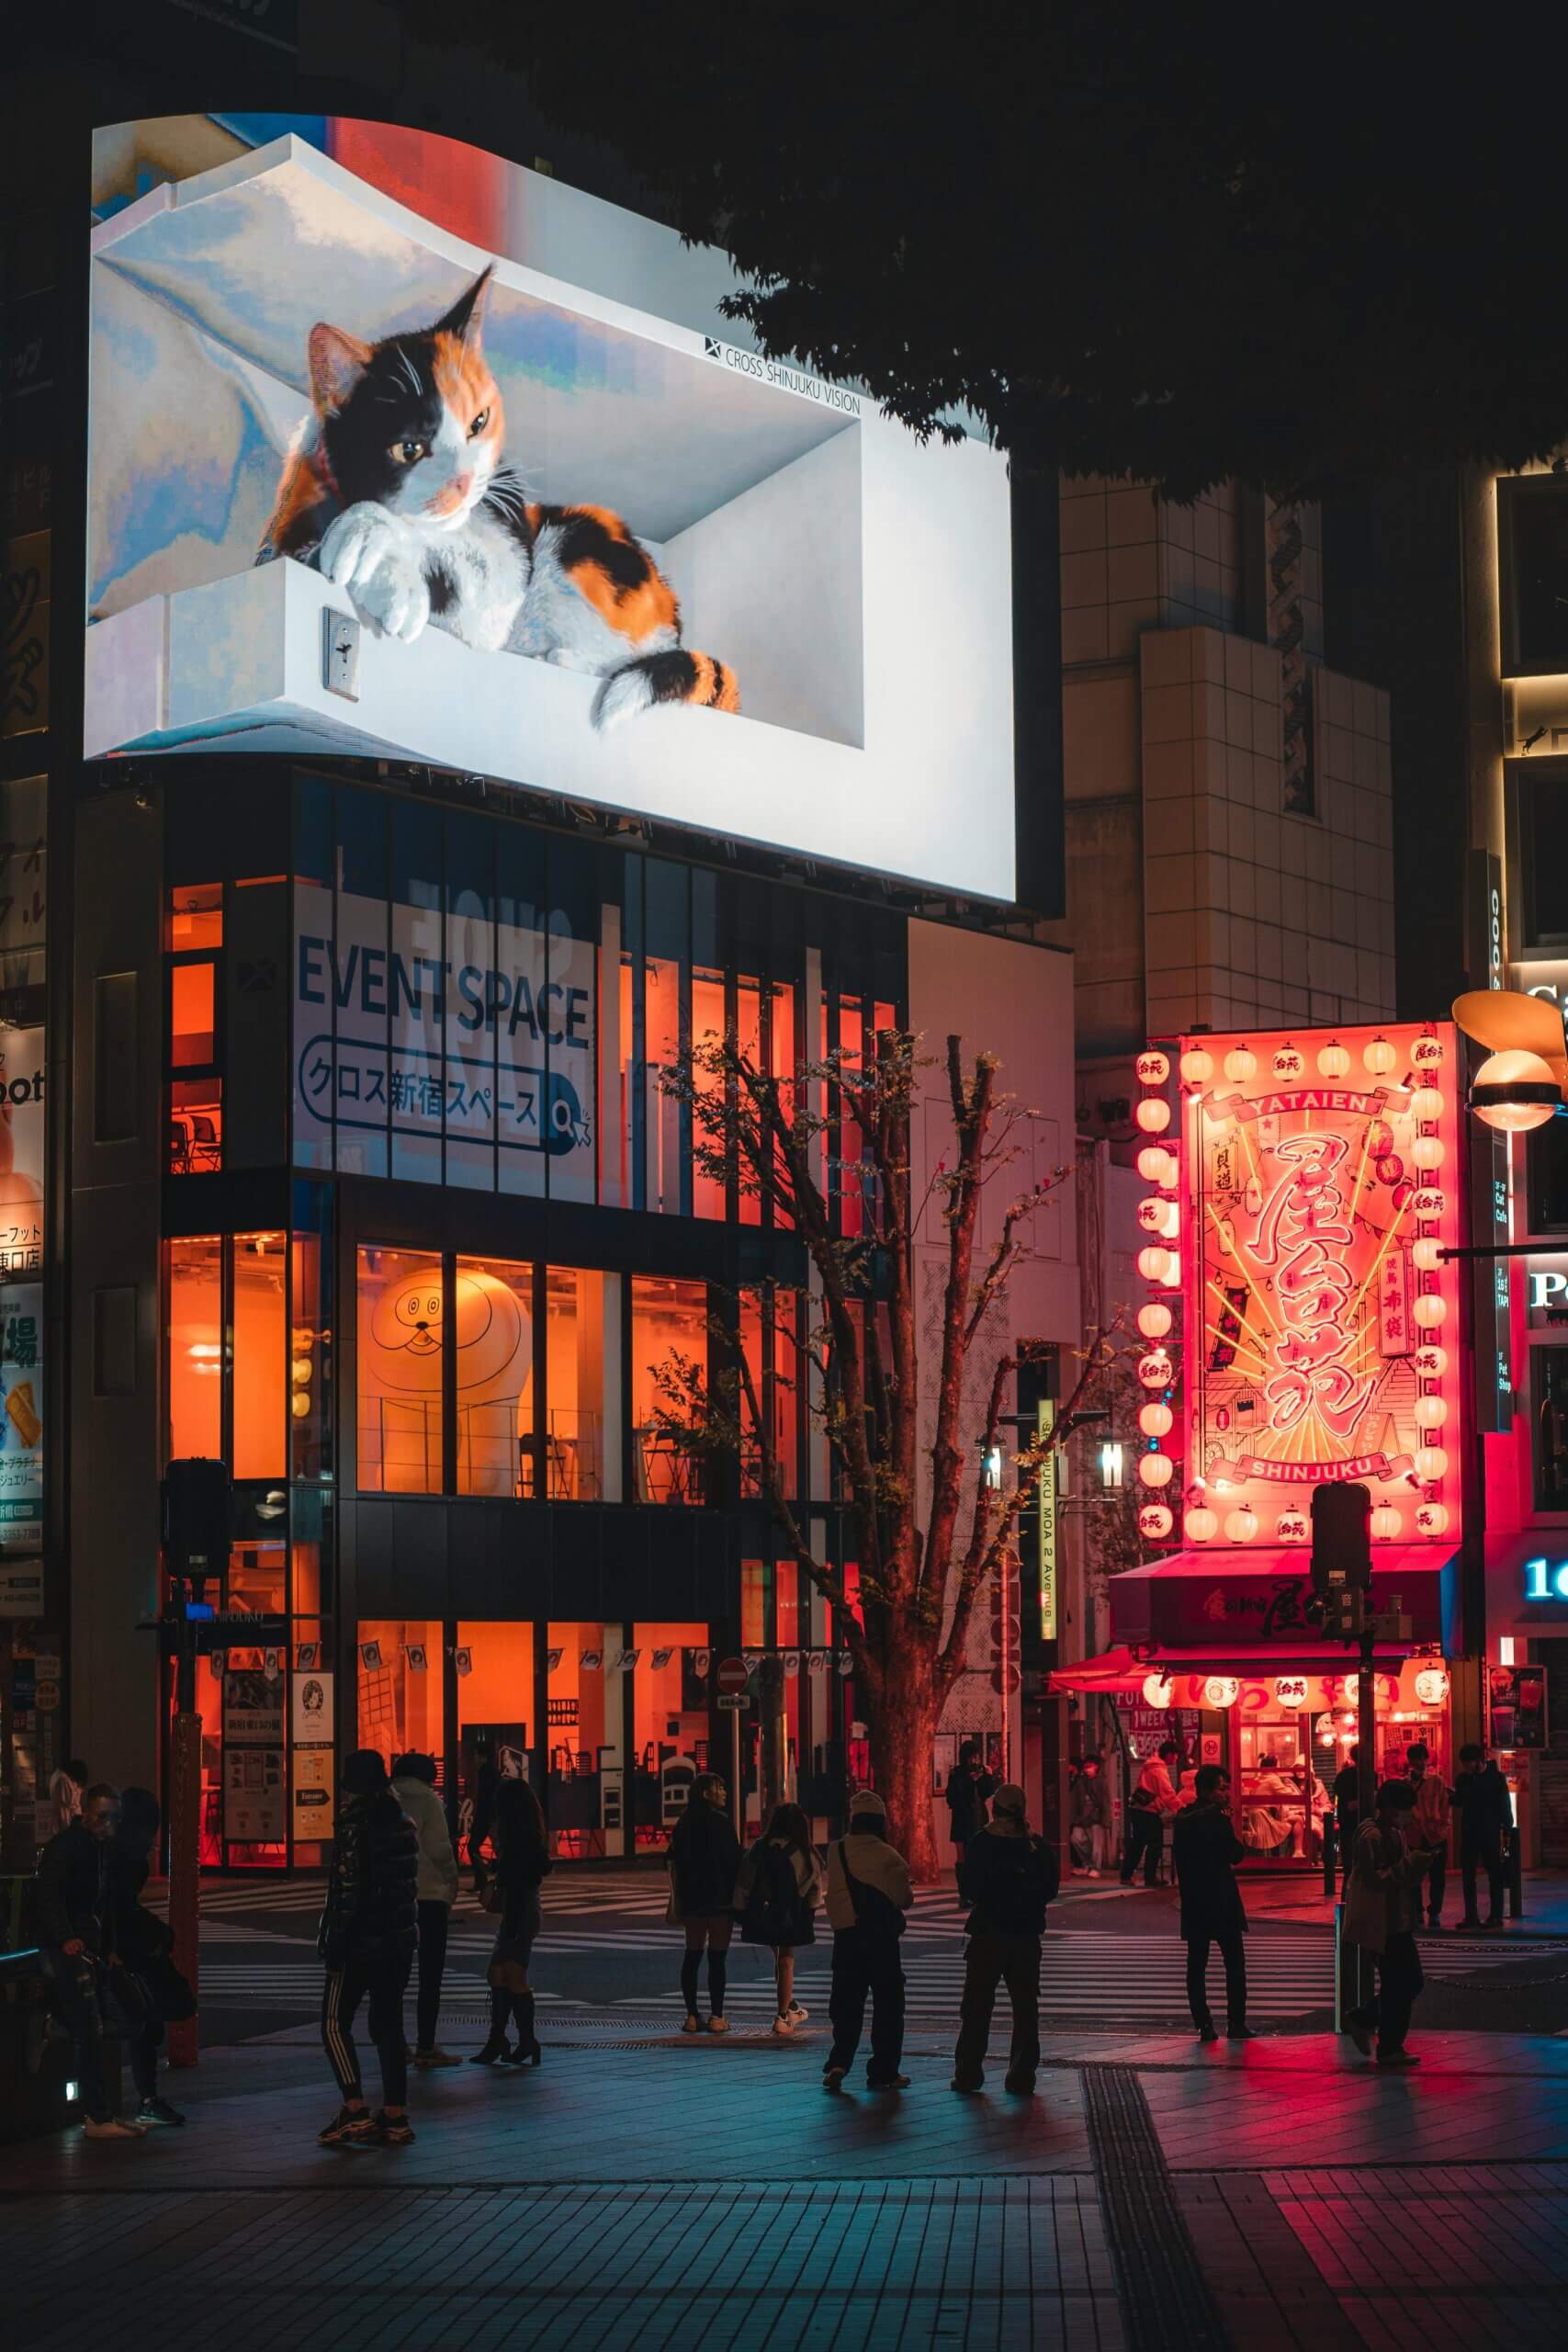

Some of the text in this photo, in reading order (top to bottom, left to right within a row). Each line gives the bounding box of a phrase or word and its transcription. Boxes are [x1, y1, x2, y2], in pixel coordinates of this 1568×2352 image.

[726, 348, 861, 414] CROSS SHINJUKU VISION
[299, 935, 590, 1050] EVENT SPACE
[0, 1070, 44, 1104] ot
[309, 1057, 537, 1126] クロス新宿スペース
[1249, 1091, 1369, 1116] YATAIEN
[1529, 1272, 1568, 1307] P
[1251, 1458, 1372, 1481] SHINJUKU
[1043, 1507, 1054, 1540] MOA
[1043, 1547, 1054, 1556] 2
[1043, 1565, 1054, 1618] Avenue
